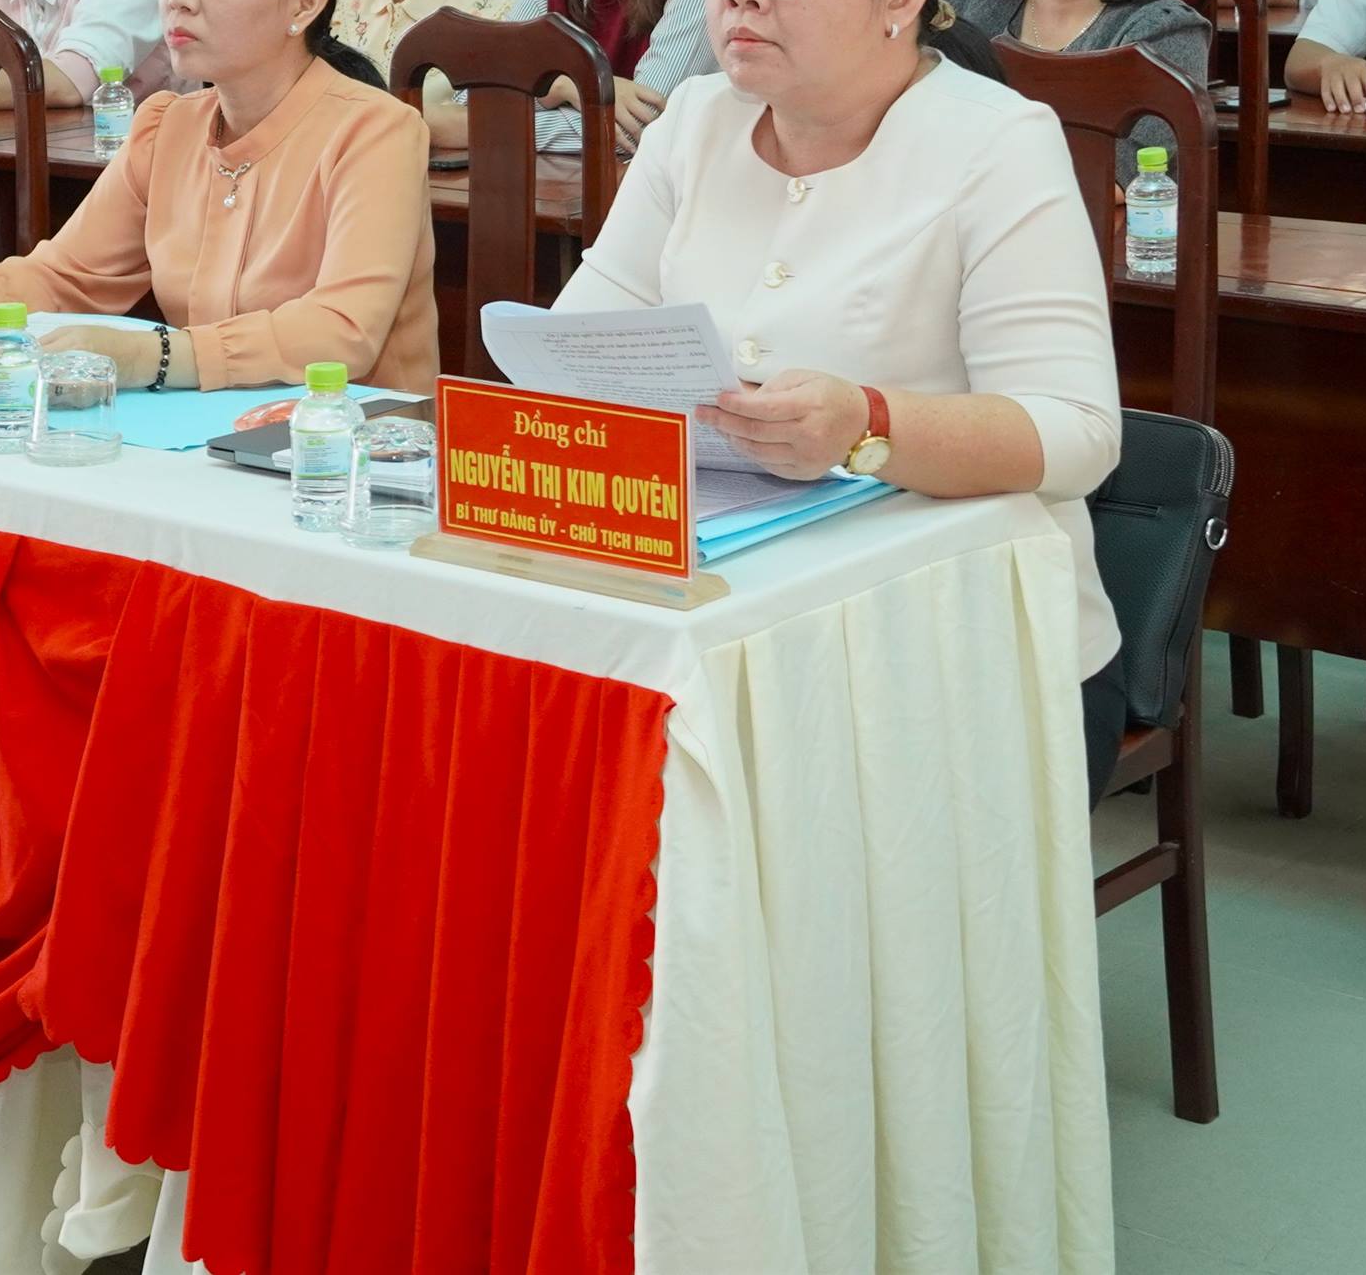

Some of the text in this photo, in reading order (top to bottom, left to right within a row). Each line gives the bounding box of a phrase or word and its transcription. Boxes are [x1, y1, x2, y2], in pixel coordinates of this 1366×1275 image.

[514, 409, 608, 448] Đồng chí
[450, 444, 678, 521] NGUYỄN THỊ KIM QUYÊN
[456, 502, 470, 520] BÍ
[472, 505, 498, 525] THƯ
[500, 508, 536, 534] ĐẢNG
[539, 513, 557, 536] ỦY
[569, 522, 597, 543] CHỦ
[600, 528, 631, 551] TỊCH
[634, 534, 674, 558] HĐND
